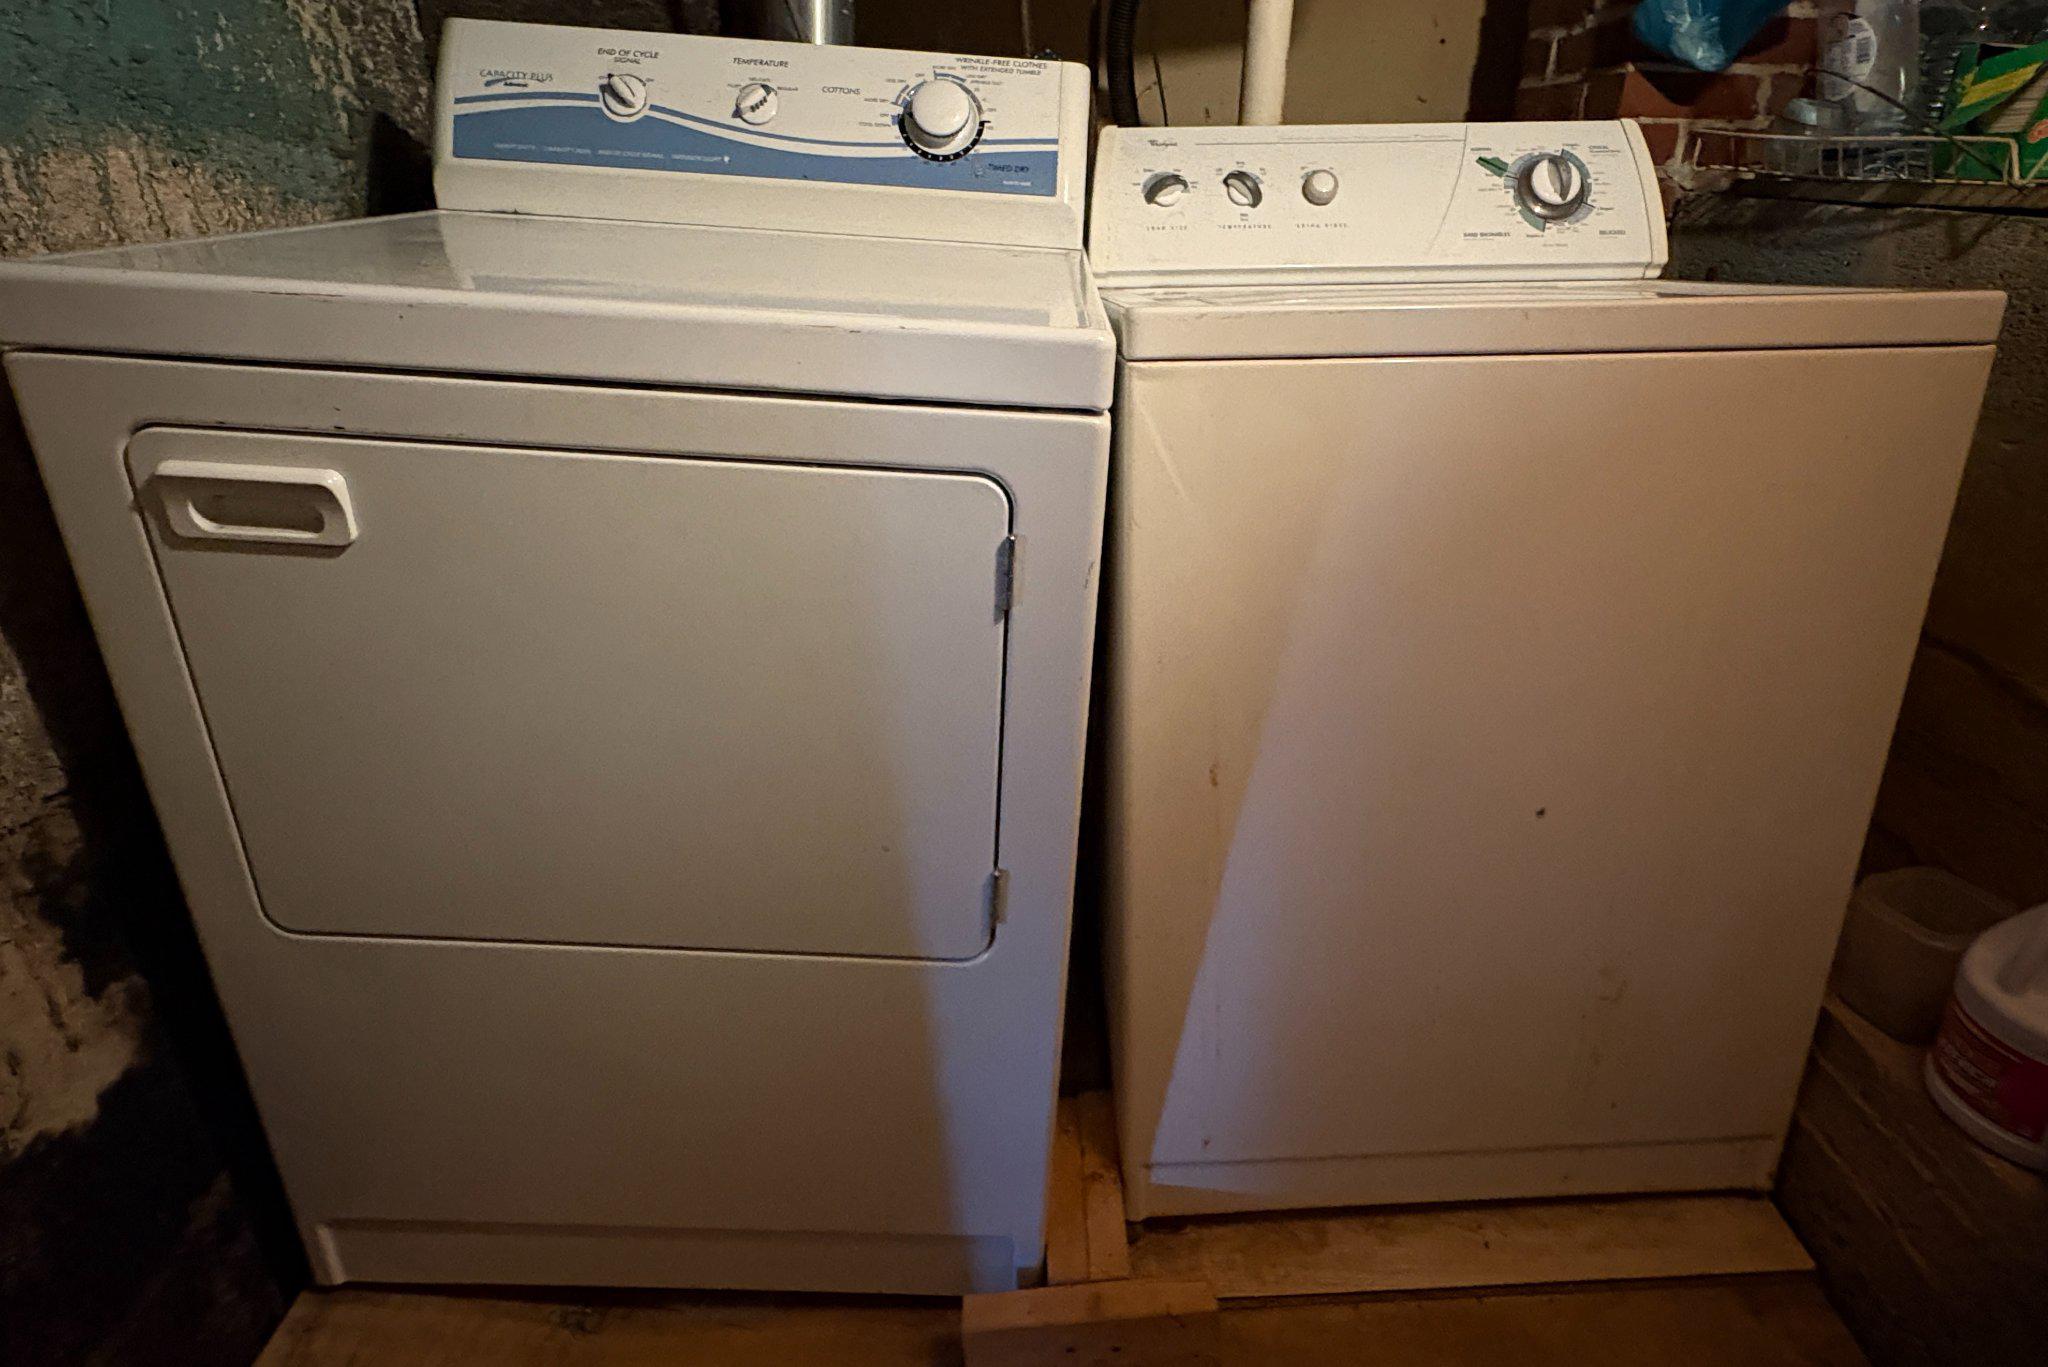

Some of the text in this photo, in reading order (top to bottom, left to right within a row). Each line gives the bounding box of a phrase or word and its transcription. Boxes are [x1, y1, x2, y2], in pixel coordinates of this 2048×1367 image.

[598, 48, 659, 59] END OF CYCLE
[733, 57, 789, 68] TEMPERATURE
[480, 69, 553, 82] CAPACITY PLUS
[980, 66, 1014, 74] EXTENDED
[822, 85, 861, 96] COTTONS
[988, 163, 1012, 173] TIMED
